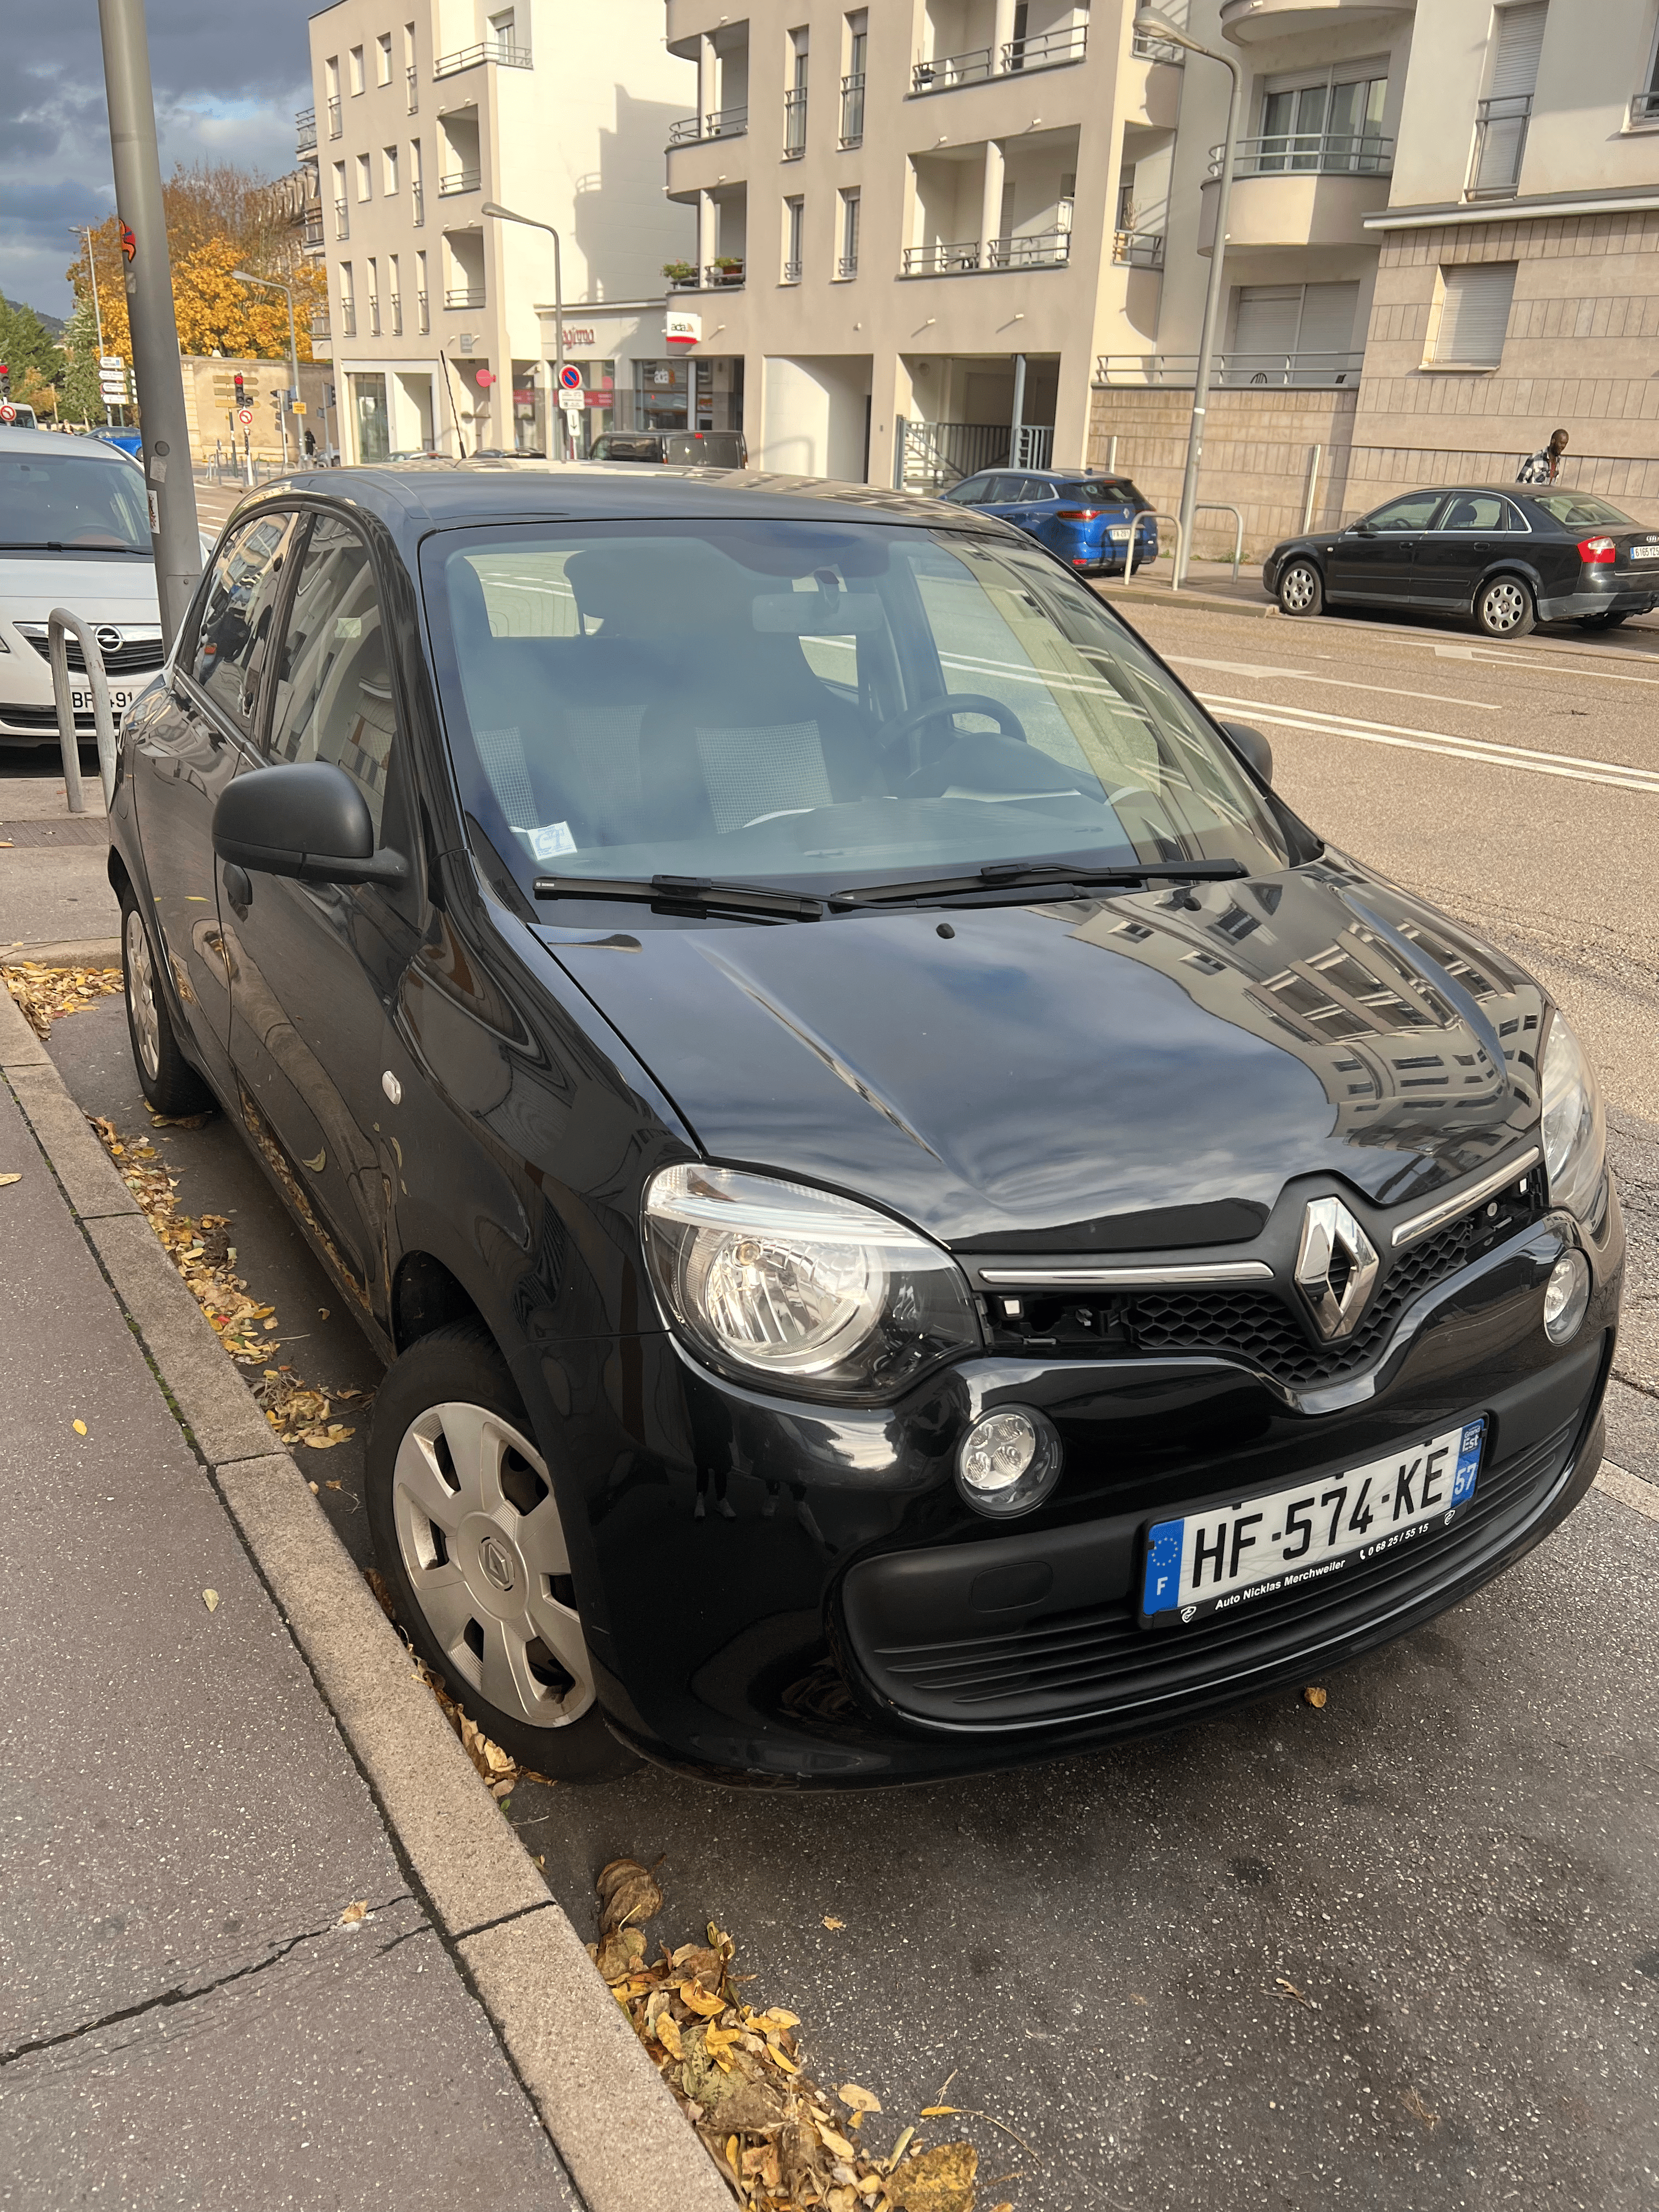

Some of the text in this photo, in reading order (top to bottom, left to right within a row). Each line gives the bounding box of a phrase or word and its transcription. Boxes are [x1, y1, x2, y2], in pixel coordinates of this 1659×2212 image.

[671, 323, 685, 331] ada
[1462, 1435, 1479, 1452] Est
[1465, 1425, 1480, 1438] Grand
[1454, 1462, 1477, 1495] 57
[1192, 1447, 1449, 1588] HF-574-KE
[1375, 1541, 1386, 1553] 68
[1387, 1535, 1399, 1547] 25
[1405, 1528, 1417, 1539] 55
[1419, 1523, 1429, 1533] 15
[1156, 1577, 1168, 1595] F
[1215, 1560, 1346, 1610] Auto Nicklas Merchweiler
